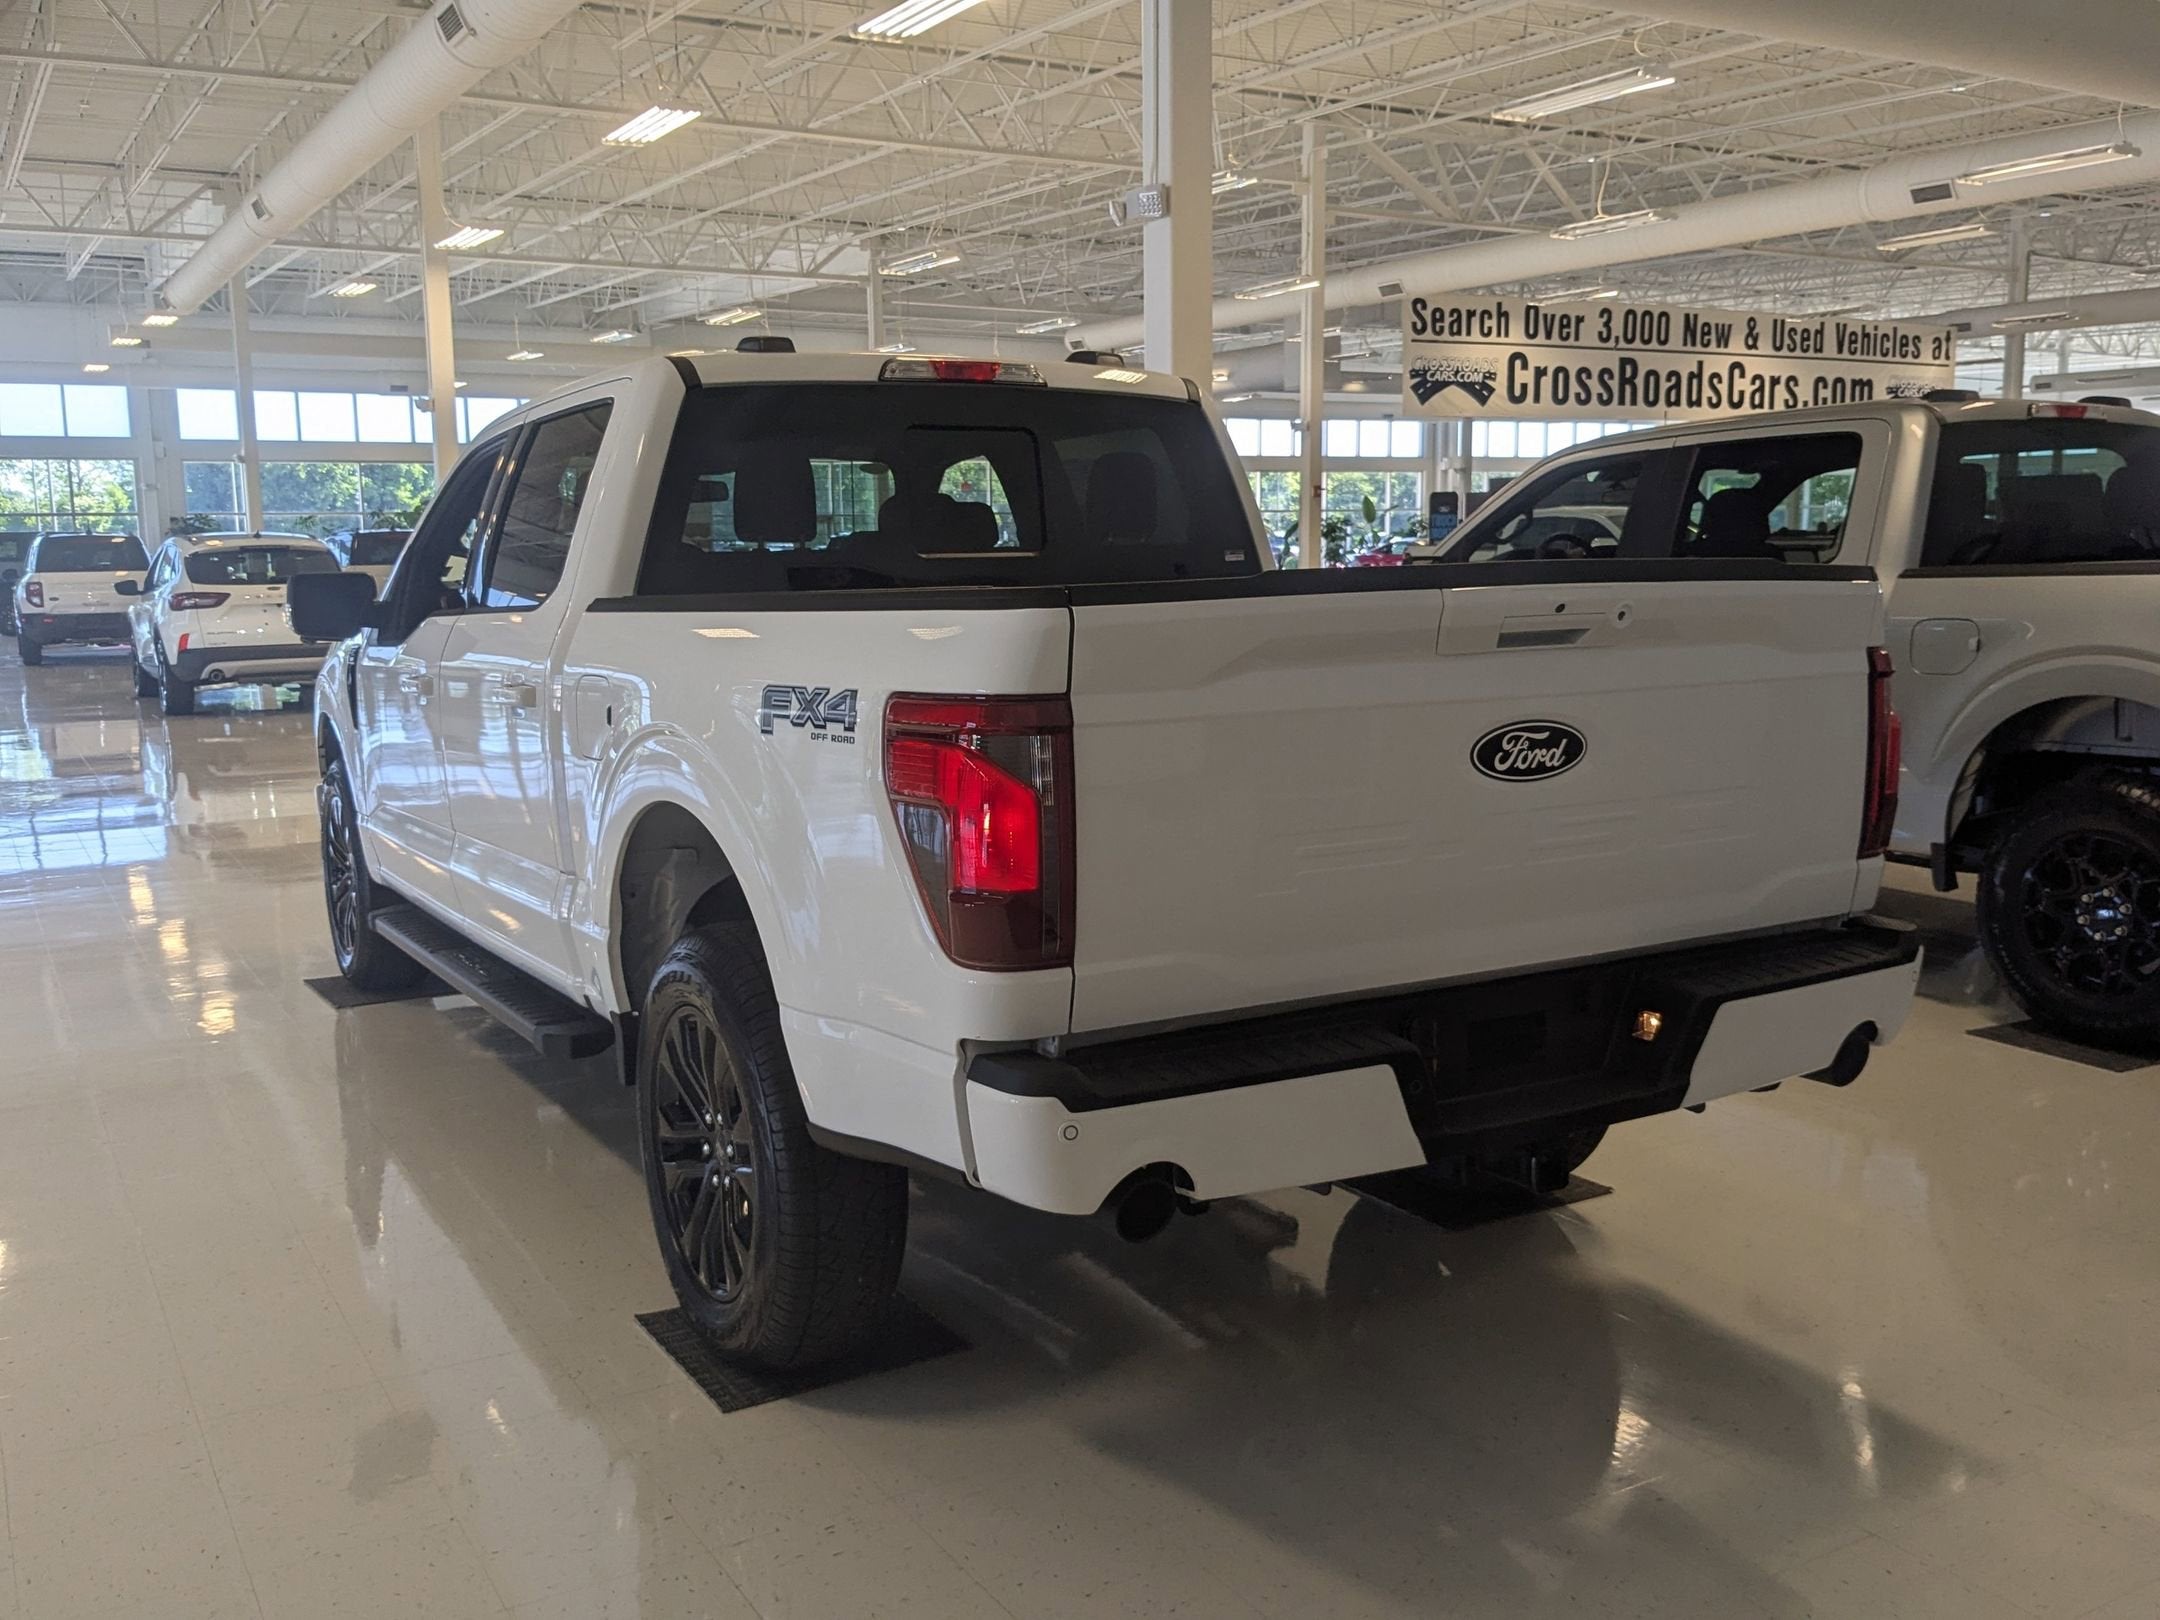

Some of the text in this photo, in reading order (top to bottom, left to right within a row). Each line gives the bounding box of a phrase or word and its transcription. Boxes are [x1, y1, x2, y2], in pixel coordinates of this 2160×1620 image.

[1411, 298, 1952, 361] Search Over 3,000 New & Used Vehicles at
[1426, 370, 1483, 383] CARS.COM
[1507, 351, 1874, 410] CrossRoadsCars.com
[760, 684, 858, 735] FX4
[810, 732, 855, 744] OFF ROAD
[1494, 731, 1567, 771] Ford
